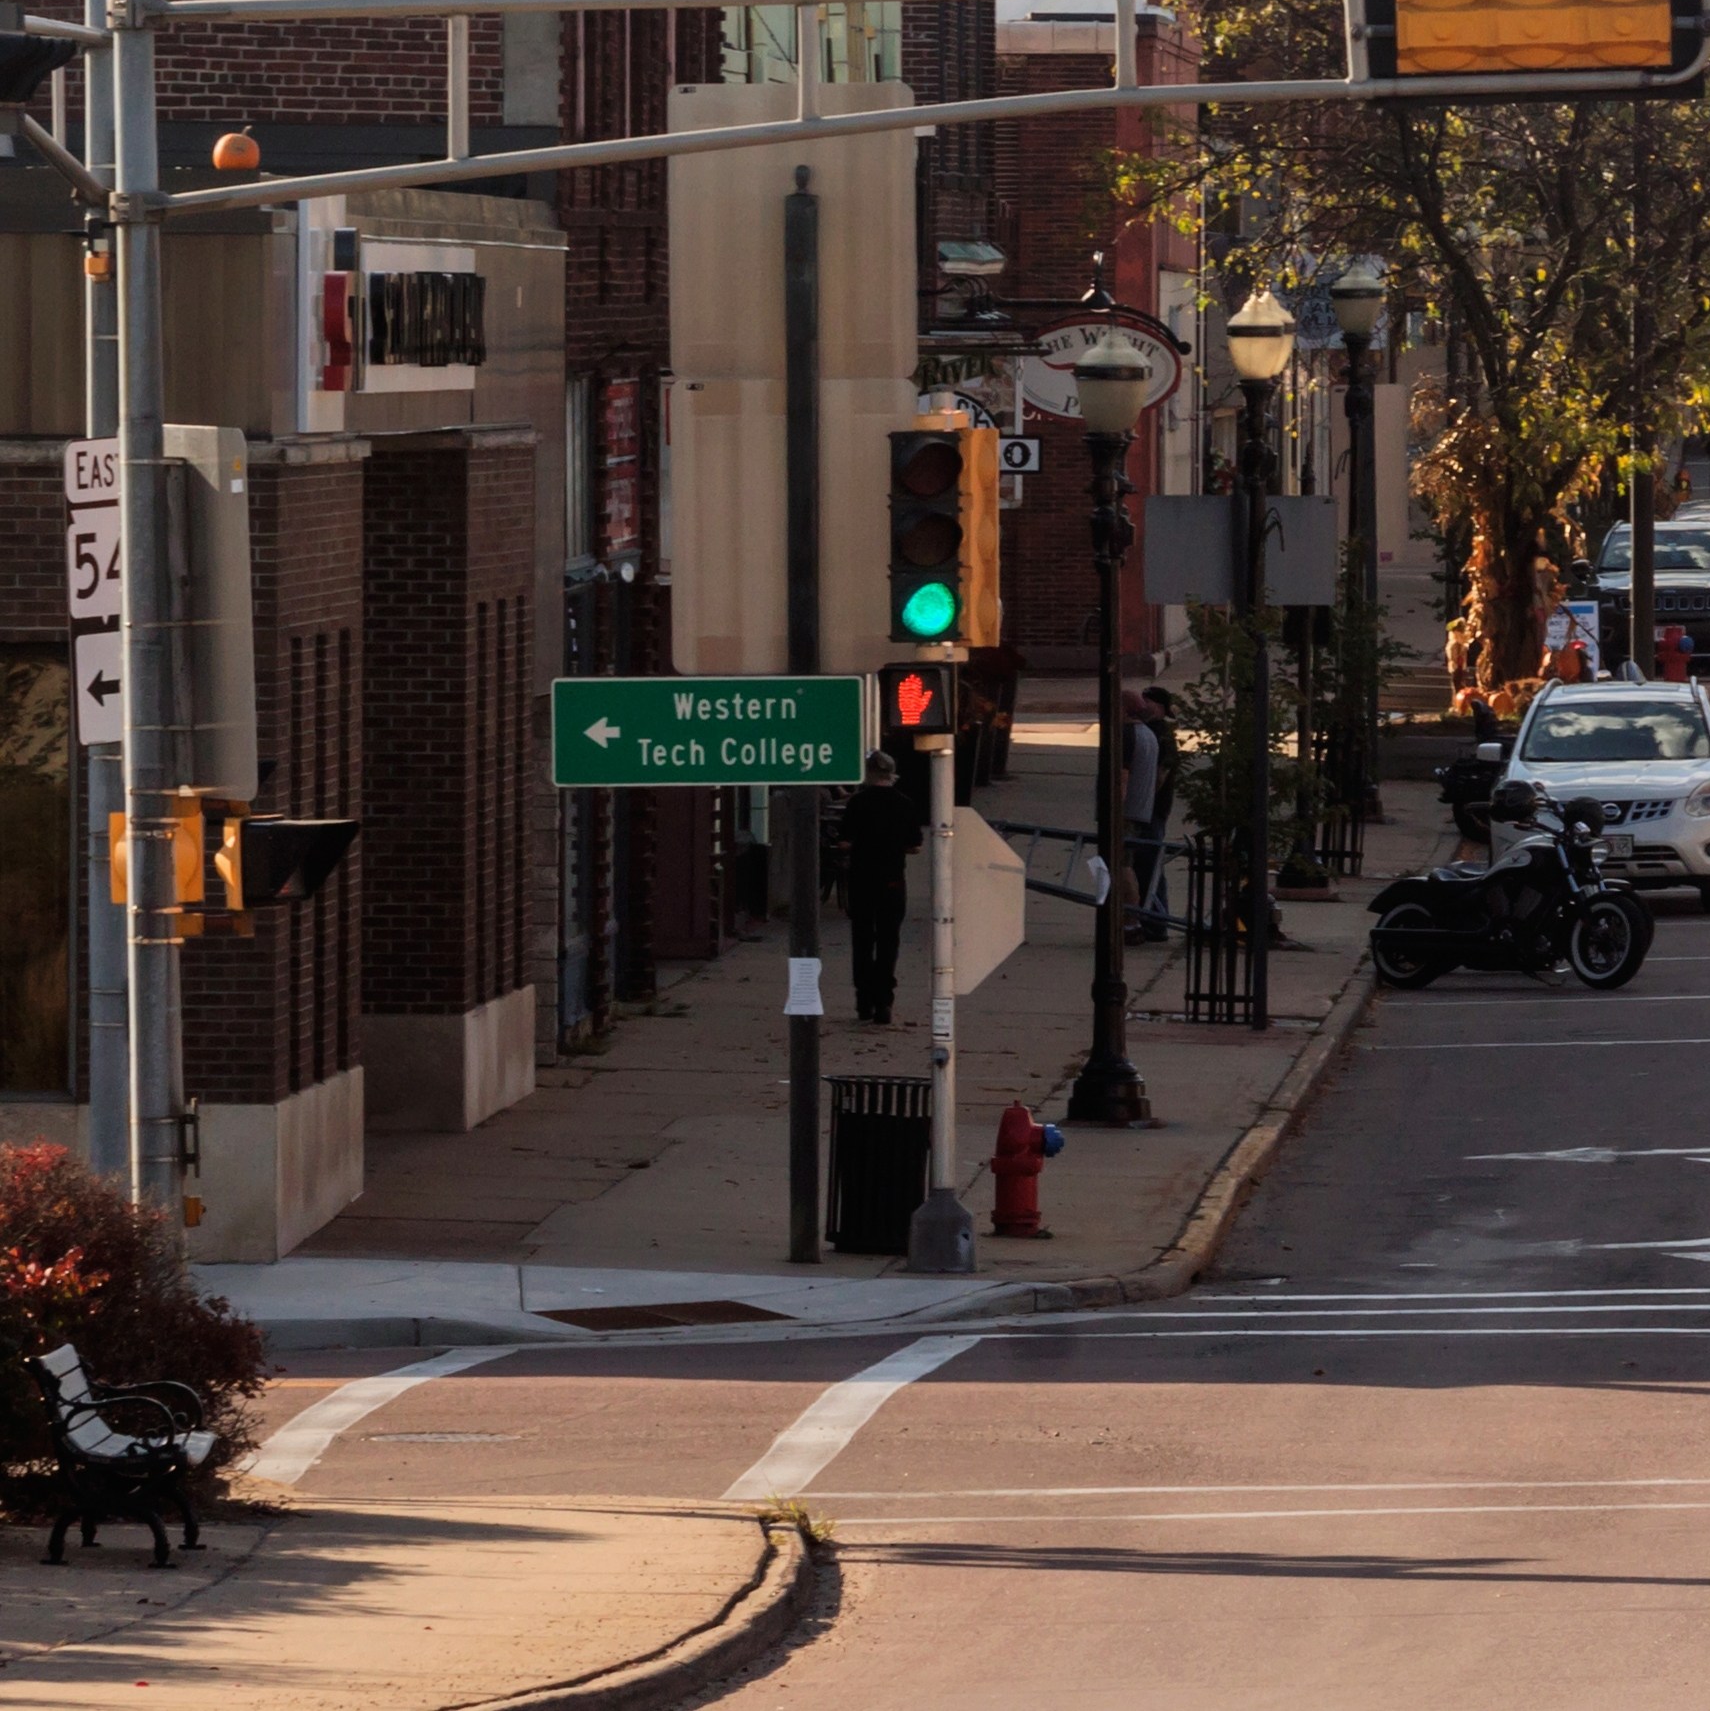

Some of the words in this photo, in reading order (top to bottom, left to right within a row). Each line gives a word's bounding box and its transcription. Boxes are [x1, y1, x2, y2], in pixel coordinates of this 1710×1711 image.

[76, 451, 119, 490] EAS
[673, 692, 797, 720] Western
[637, 738, 706, 766] Tech
[721, 737, 834, 772] College
